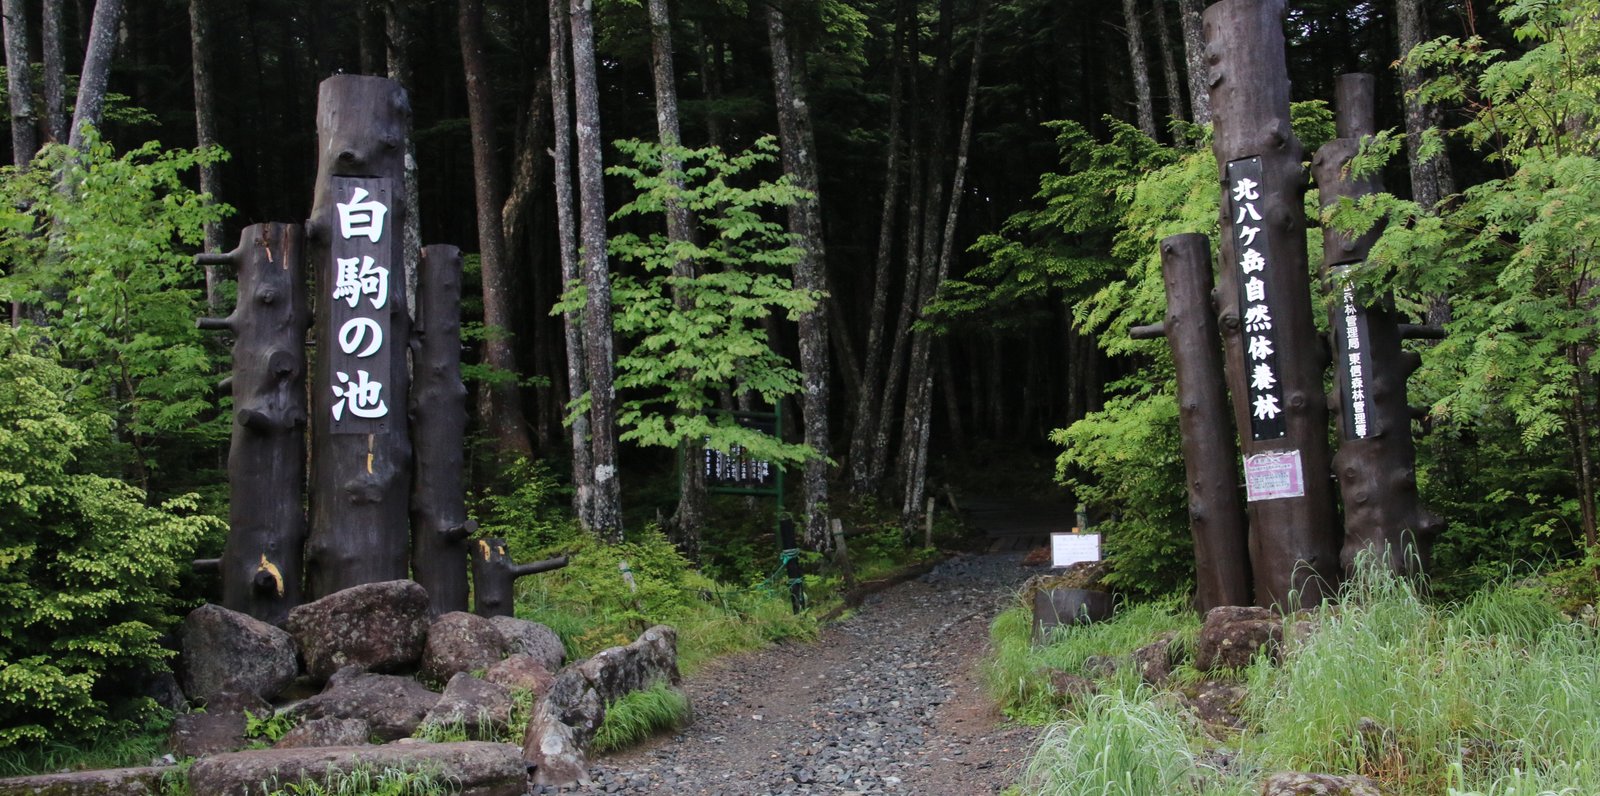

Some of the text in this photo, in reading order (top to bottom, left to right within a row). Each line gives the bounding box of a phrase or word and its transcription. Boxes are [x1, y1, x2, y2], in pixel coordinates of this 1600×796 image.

[332, 187, 389, 421] 白駒の池
[1348, 352, 1367, 436] 東信森林管理署
